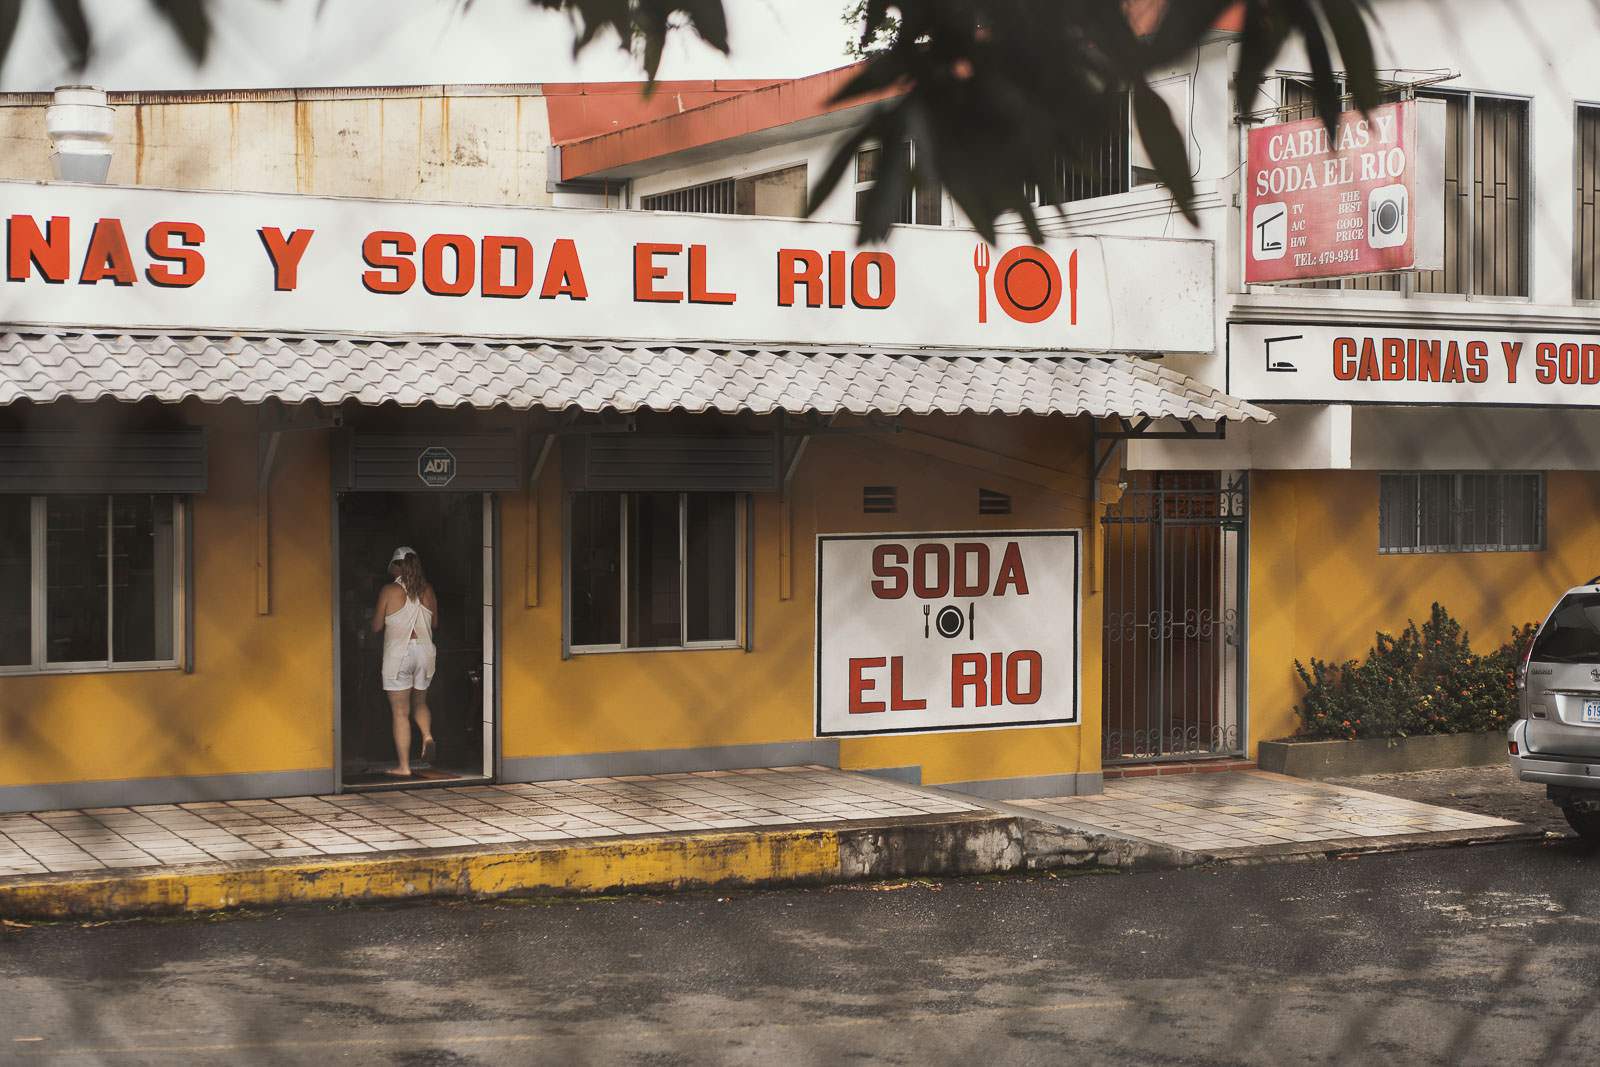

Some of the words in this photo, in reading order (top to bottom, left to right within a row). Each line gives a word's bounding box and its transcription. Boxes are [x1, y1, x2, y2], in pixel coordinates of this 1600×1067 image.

[1376, 115, 1392, 144] Y
[1256, 163, 1317, 197] SODA
[1322, 156, 1354, 187] EL
[1359, 147, 1406, 181] RIO
[1340, 190, 1361, 202] THE
[1291, 204, 1305, 215] TV
[1338, 201, 1362, 214] BEST
[1336, 217, 1363, 230] GOOD
[1335, 229, 1364, 243] PRICE
[6, 215, 205, 288] NAS
[258, 226, 314, 292] Y
[361, 231, 588, 301] SODA
[633, 242, 737, 306] EL
[777, 248, 896, 310] RIO
[1294, 253, 1317, 267] TEL:
[1319, 248, 1359, 265] 479-9341
[1333, 337, 1489, 384] CABINAS
[1501, 341, 1524, 384] Y
[424, 459, 450, 473] ADT
[871, 542, 1029, 600] SODA
[848, 655, 927, 715] EL
[951, 649, 1043, 709] RIO
